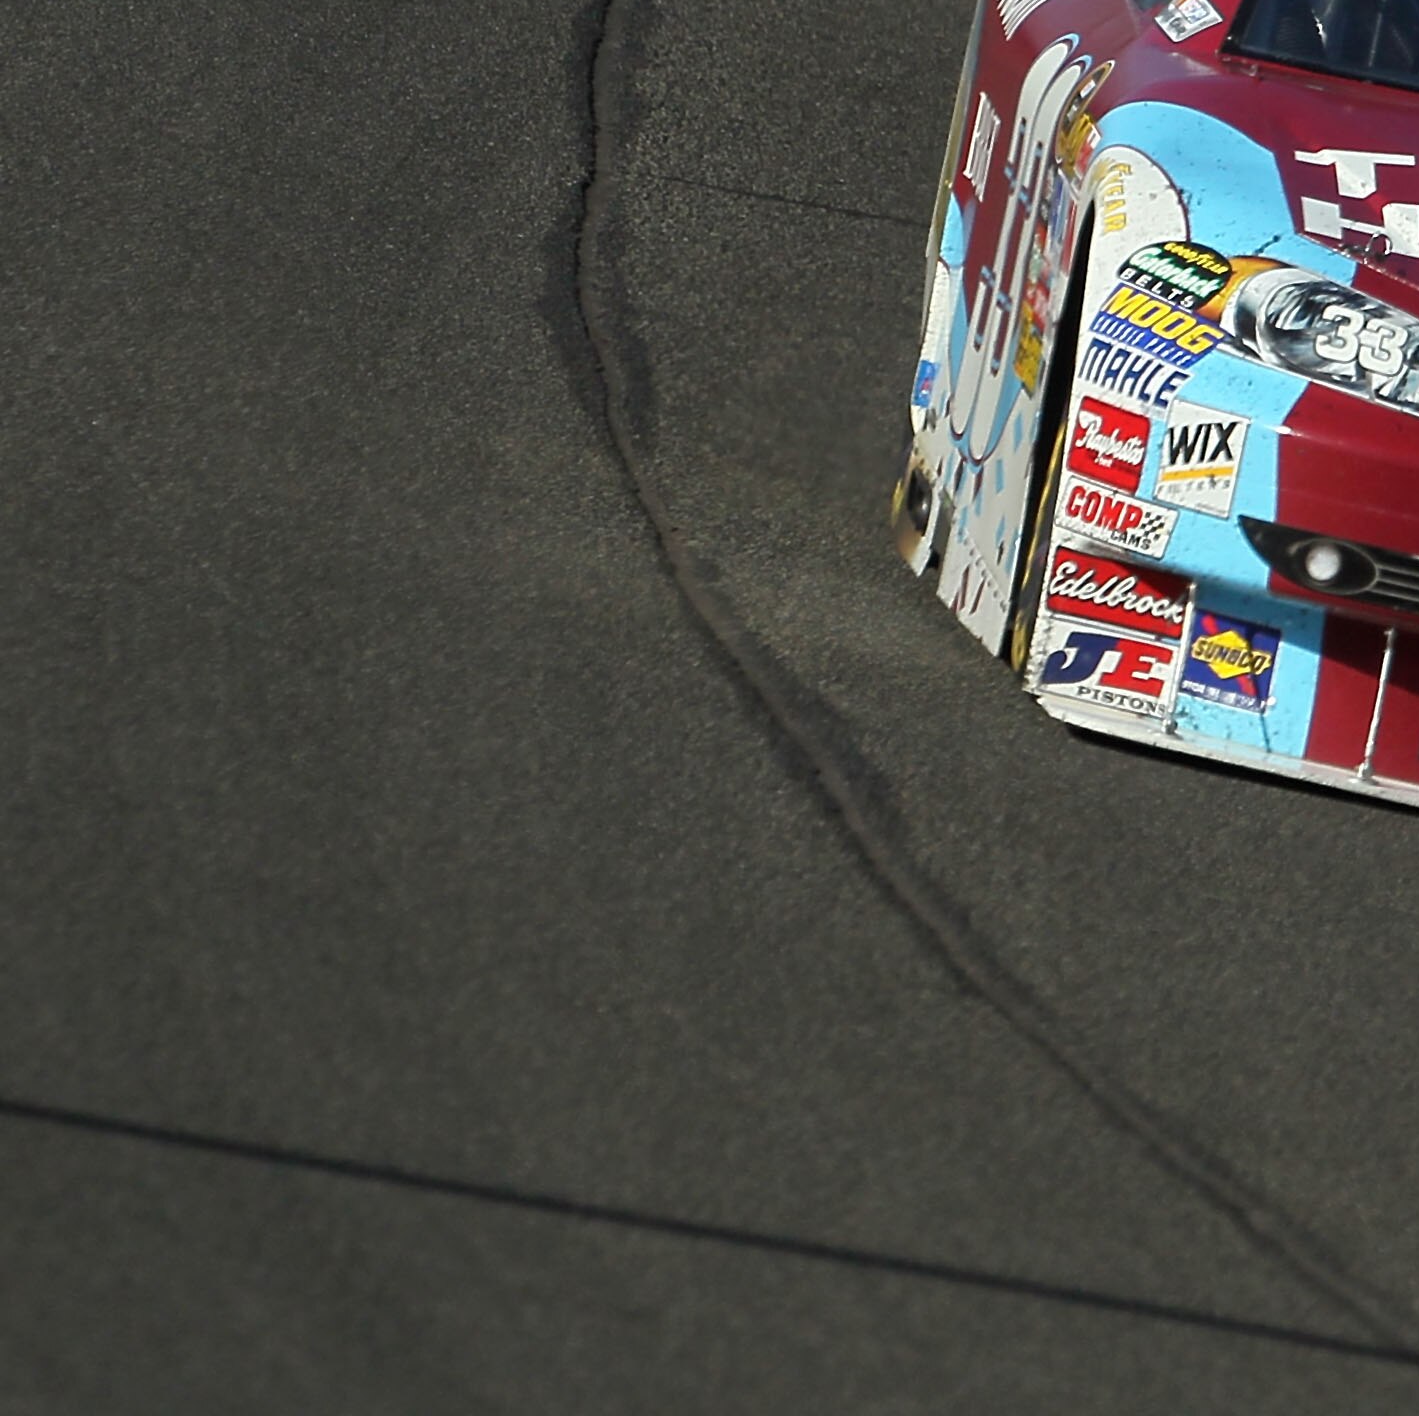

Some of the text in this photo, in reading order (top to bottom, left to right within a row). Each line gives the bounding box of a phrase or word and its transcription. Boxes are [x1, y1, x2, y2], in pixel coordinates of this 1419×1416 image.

[1120, 268, 1194, 307] BELTS
[1129, 247, 1221, 298] Gatorback
[1100, 287, 1224, 354] MOOG
[1315, 305, 1410, 376] 33
[1078, 338, 1190, 408] MAHLE
[1168, 422, 1238, 465] WIX
[1066, 485, 1143, 533] COMP
[1110, 527, 1151, 551] CAMS
[1050, 562, 1183, 623] Edelbrock
[1041, 632, 1173, 697] JE
[1194, 640, 1269, 674] SUNOCO
[1077, 686, 1167, 714] PISTONS
